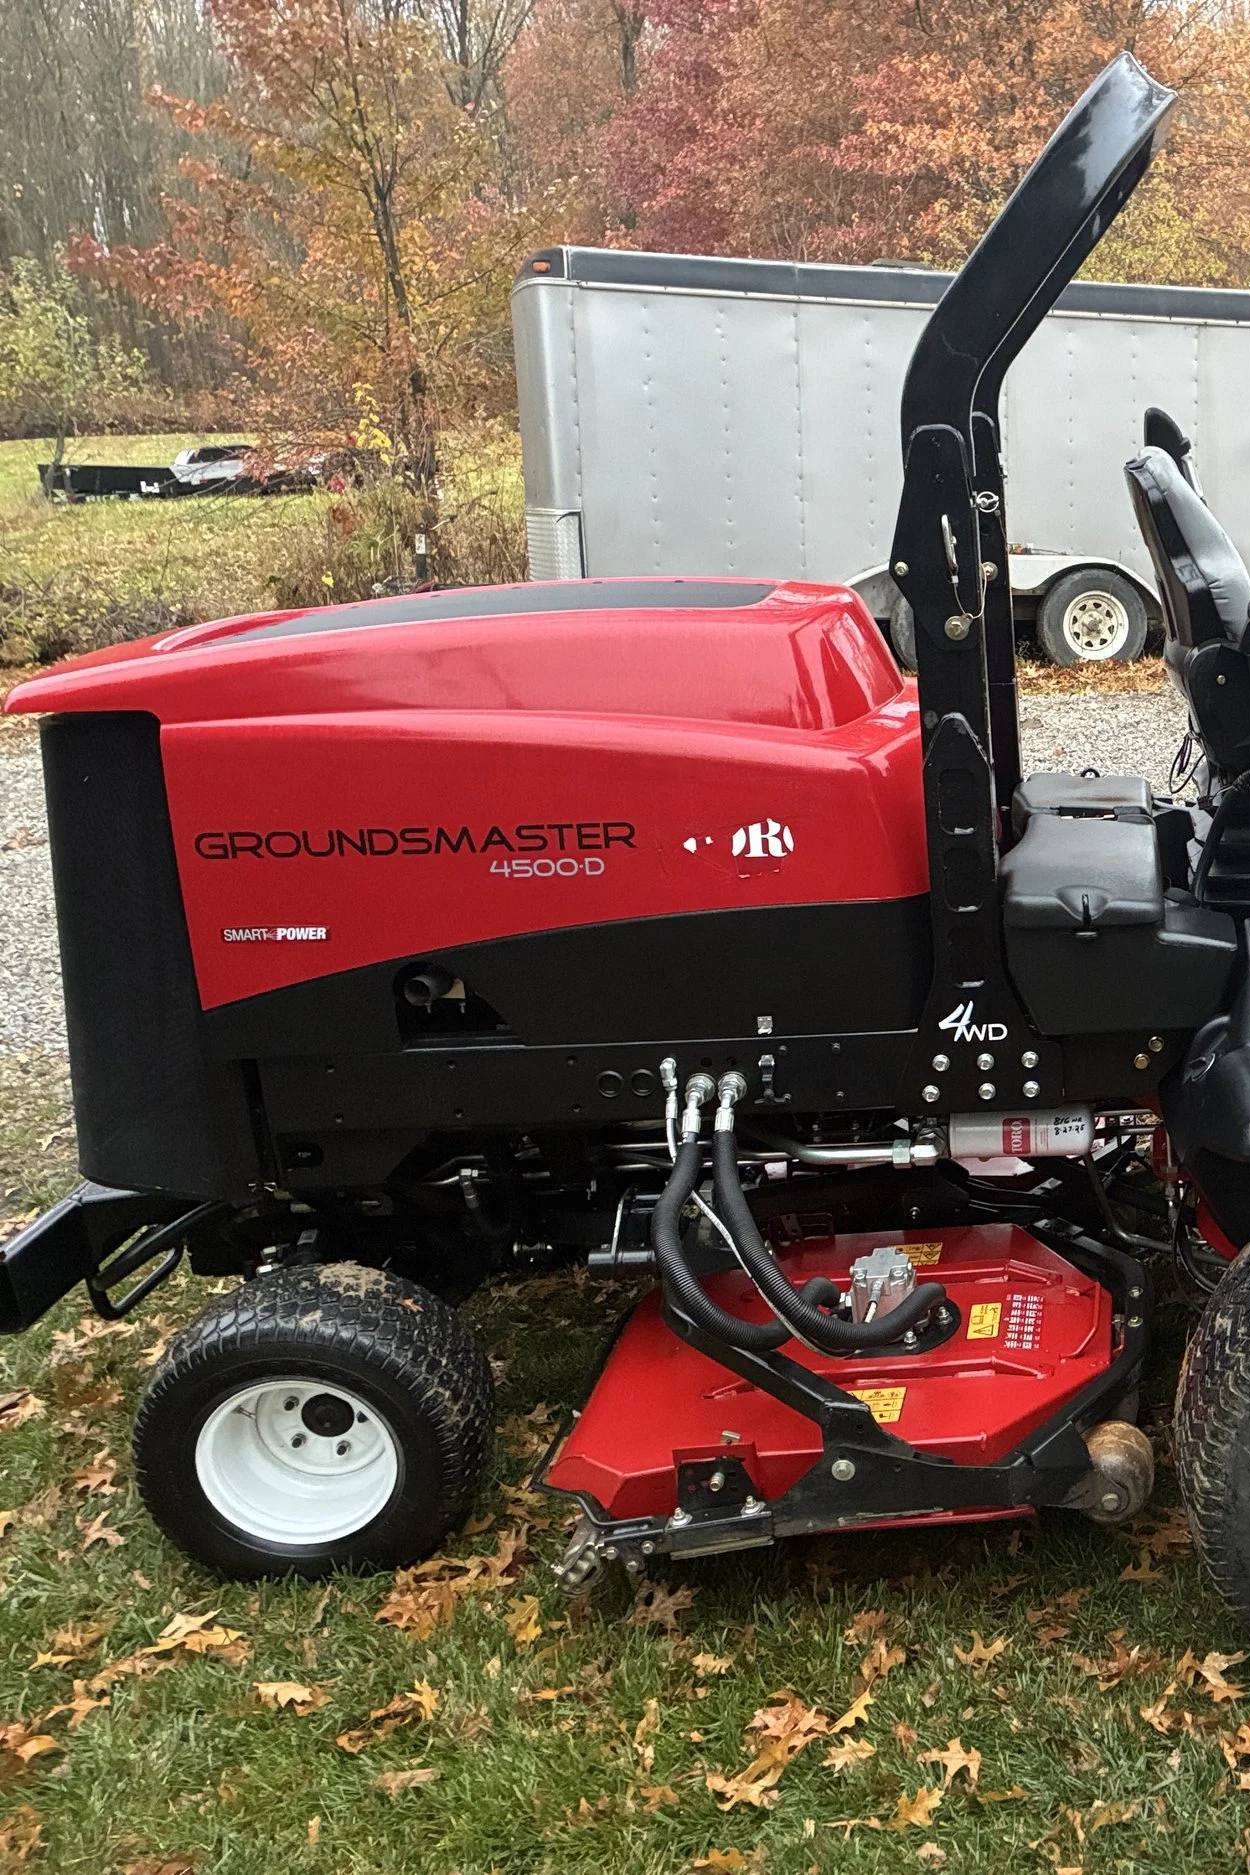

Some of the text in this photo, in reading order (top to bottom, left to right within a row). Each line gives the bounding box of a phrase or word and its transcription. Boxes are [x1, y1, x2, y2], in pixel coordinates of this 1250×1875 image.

[194, 821, 638, 860] GROUNDSMASTER
[938, 1000, 1008, 1042] 4WD
[1011, 1120, 1023, 1153] TORO
